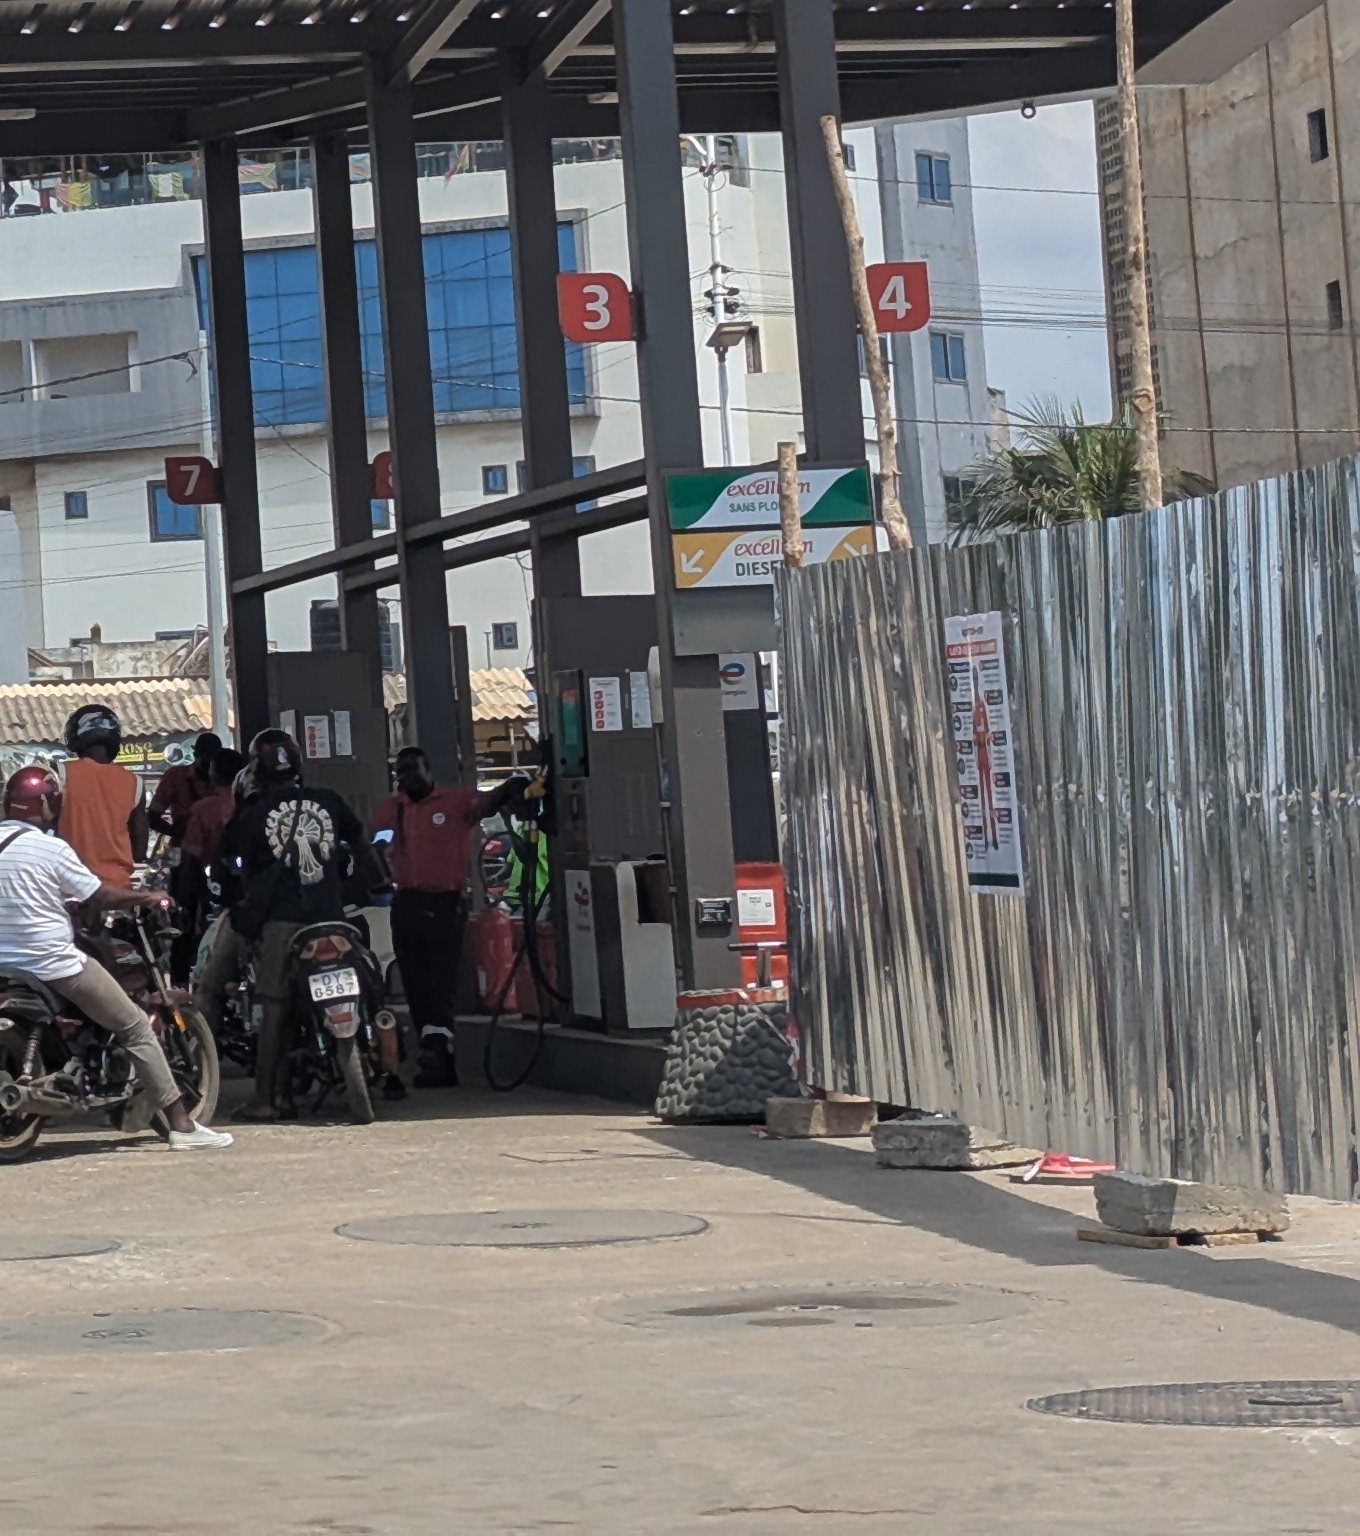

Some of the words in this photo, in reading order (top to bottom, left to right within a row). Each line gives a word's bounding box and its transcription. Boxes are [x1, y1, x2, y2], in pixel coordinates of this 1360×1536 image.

[582, 275, 610, 330] 3
[878, 275, 912, 320] 4
[180, 465, 201, 496] 7
[726, 480, 811, 497] excellm
[729, 501, 756, 513] SANS
[758, 500, 780, 512] PLO
[734, 539, 813, 557] excellm
